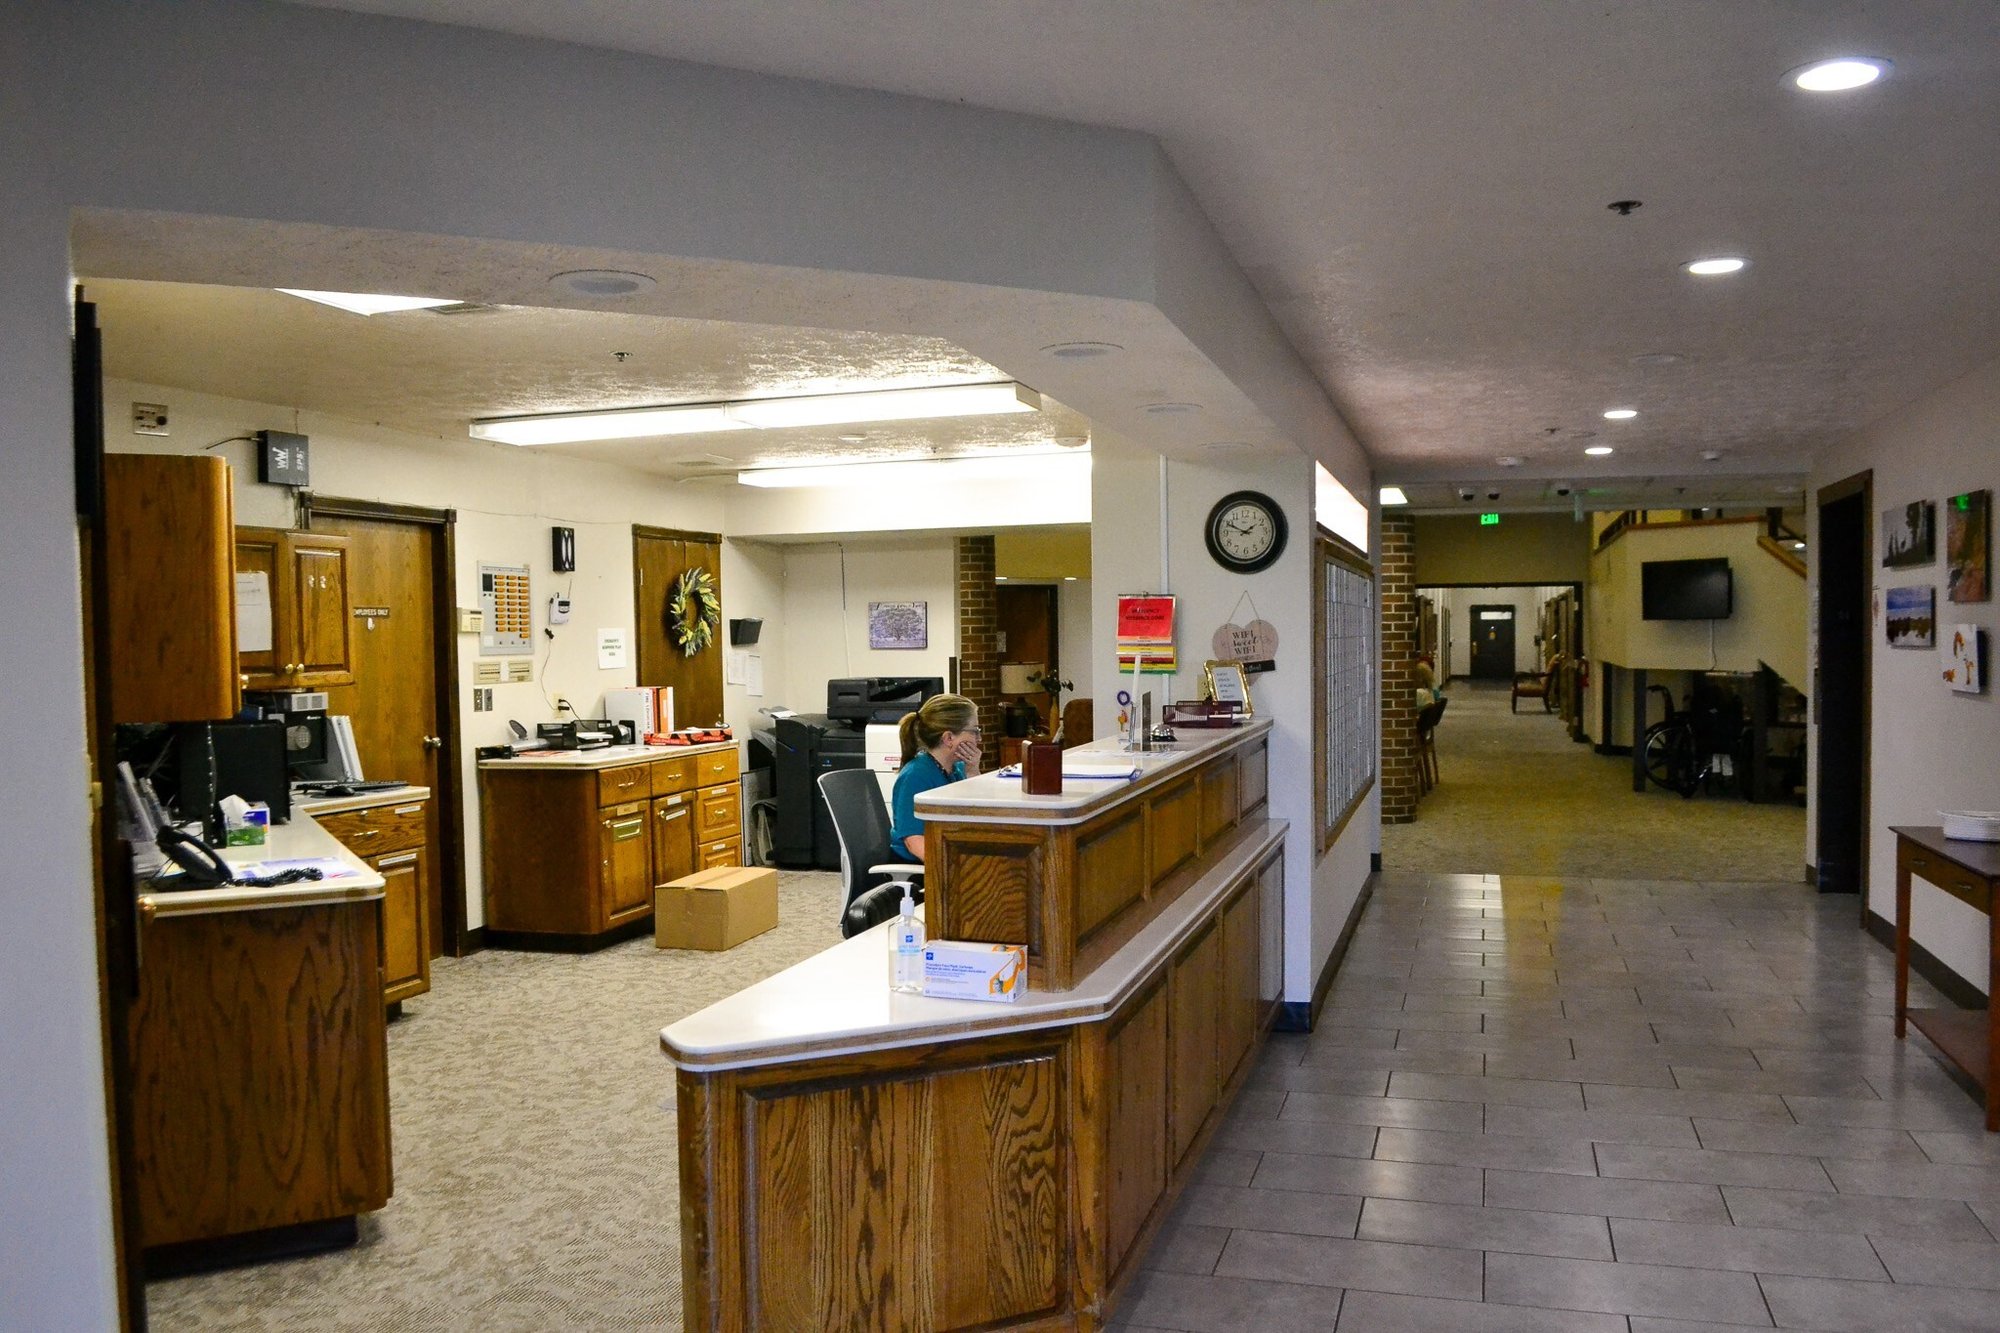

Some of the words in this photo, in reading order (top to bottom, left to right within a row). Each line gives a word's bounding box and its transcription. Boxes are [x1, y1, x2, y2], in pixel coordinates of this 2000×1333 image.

[1241, 510, 1249, 518] 12
[1223, 529, 1229, 537] 9
[1226, 539, 1232, 547] 8
[1234, 545, 1239, 553] 7
[1243, 546, 1249, 554] 6
[1232, 629, 1254, 639] WIFI
[1234, 645, 1256, 655] WIFI
